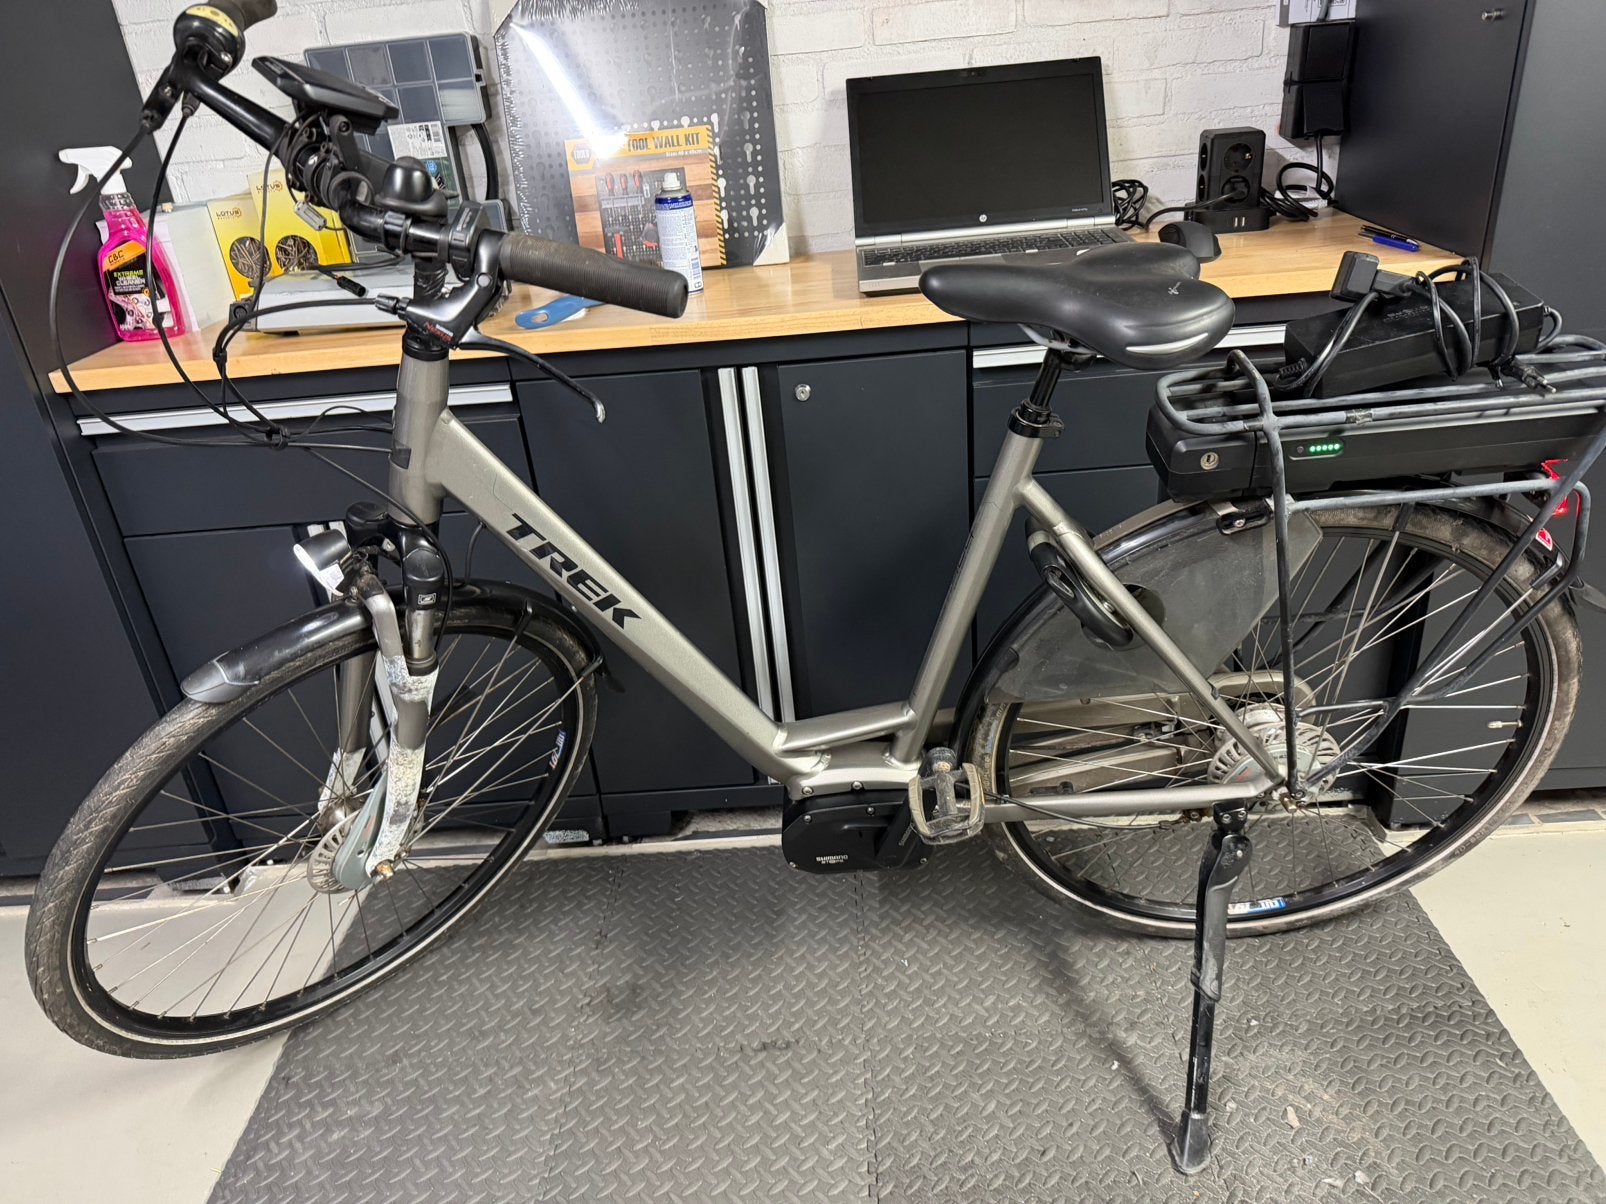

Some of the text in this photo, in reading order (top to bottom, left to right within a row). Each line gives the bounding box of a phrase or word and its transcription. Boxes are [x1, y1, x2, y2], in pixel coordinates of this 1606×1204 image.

[653, 134, 682, 149] WALL
[685, 132, 701, 146] KIT
[216, 209, 240, 217] LOTUS
[506, 512, 642, 630] TREK
